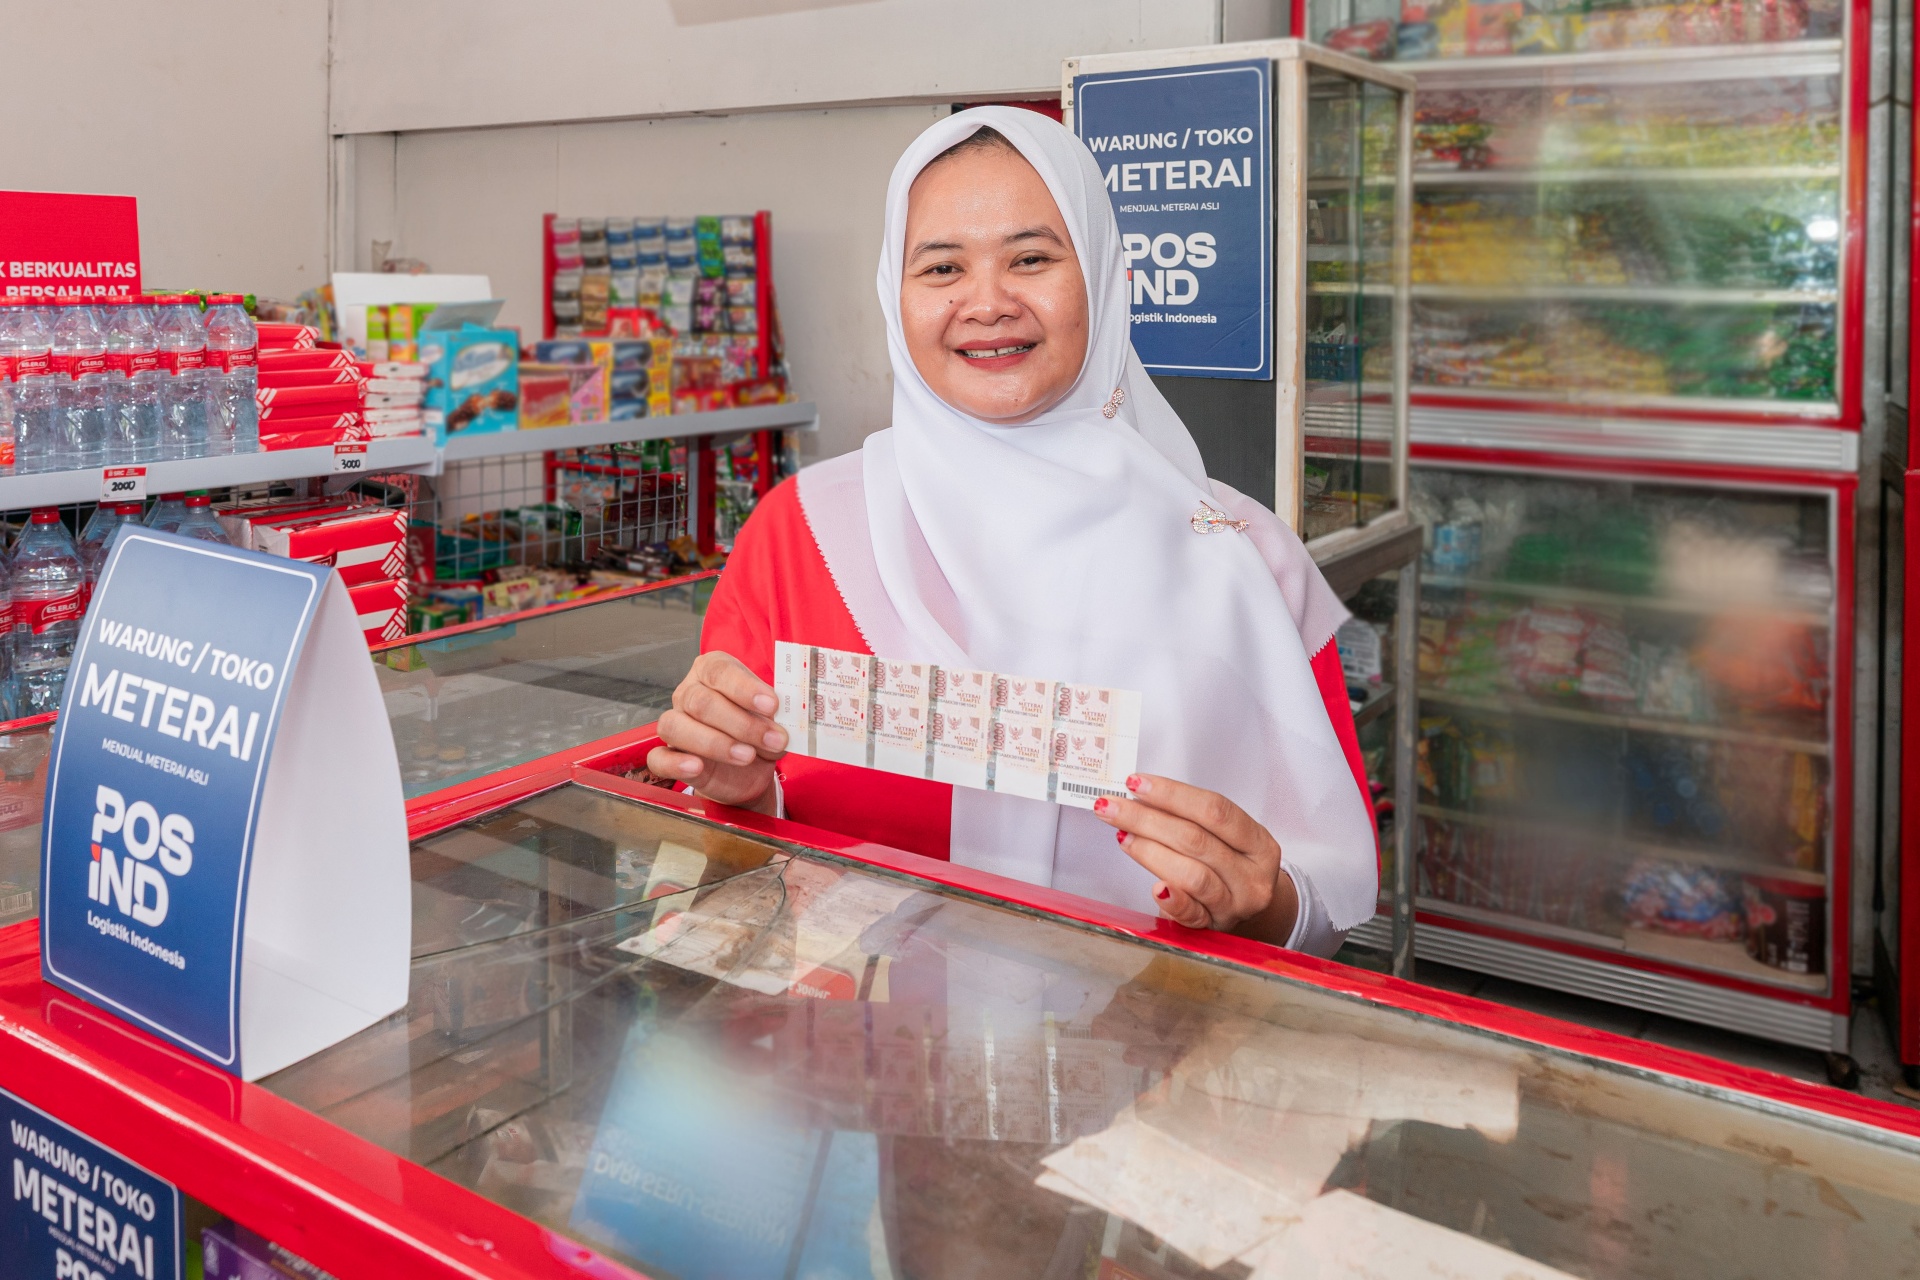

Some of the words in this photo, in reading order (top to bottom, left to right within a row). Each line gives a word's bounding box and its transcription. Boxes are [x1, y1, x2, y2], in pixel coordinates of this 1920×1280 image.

[1088, 131, 1177, 153] WARUNG
[1181, 128, 1191, 149] /
[1194, 127, 1253, 147] TOKO
[1119, 204, 1159, 213] MENJUAL
[1161, 202, 1199, 212] METERAI
[1200, 202, 1220, 211] ASLI
[1122, 232, 1217, 268] POS
[9, 261, 137, 278] BERKUALITAS
[6, 285, 130, 297] BERSAHABAT
[1130, 312, 1163, 325] ogistik
[1165, 313, 1217, 324] Indonesia
[341, 459, 361, 469] 3000
[111, 480, 136, 491] 2000
[46, 602, 77, 613] ES.ER.CE
[99, 618, 194, 667] WARUNG
[191, 642, 211, 674] /
[210, 649, 275, 691] TOKO
[80, 662, 260, 762] METERAI
[102, 737, 144, 764] MENJUAL
[145, 752, 187, 778] METERAI
[186, 768, 210, 787] ASLI
[92, 784, 194, 877] POS
[88, 910, 130, 944] Logistik
[131, 930, 185, 970] Indonesia
[11, 1119, 90, 1184] WARUNG
[102, 1170, 156, 1221] TOKO
[13, 1158, 154, 1280] METERAI
[56, 1247, 106, 1280] PO
